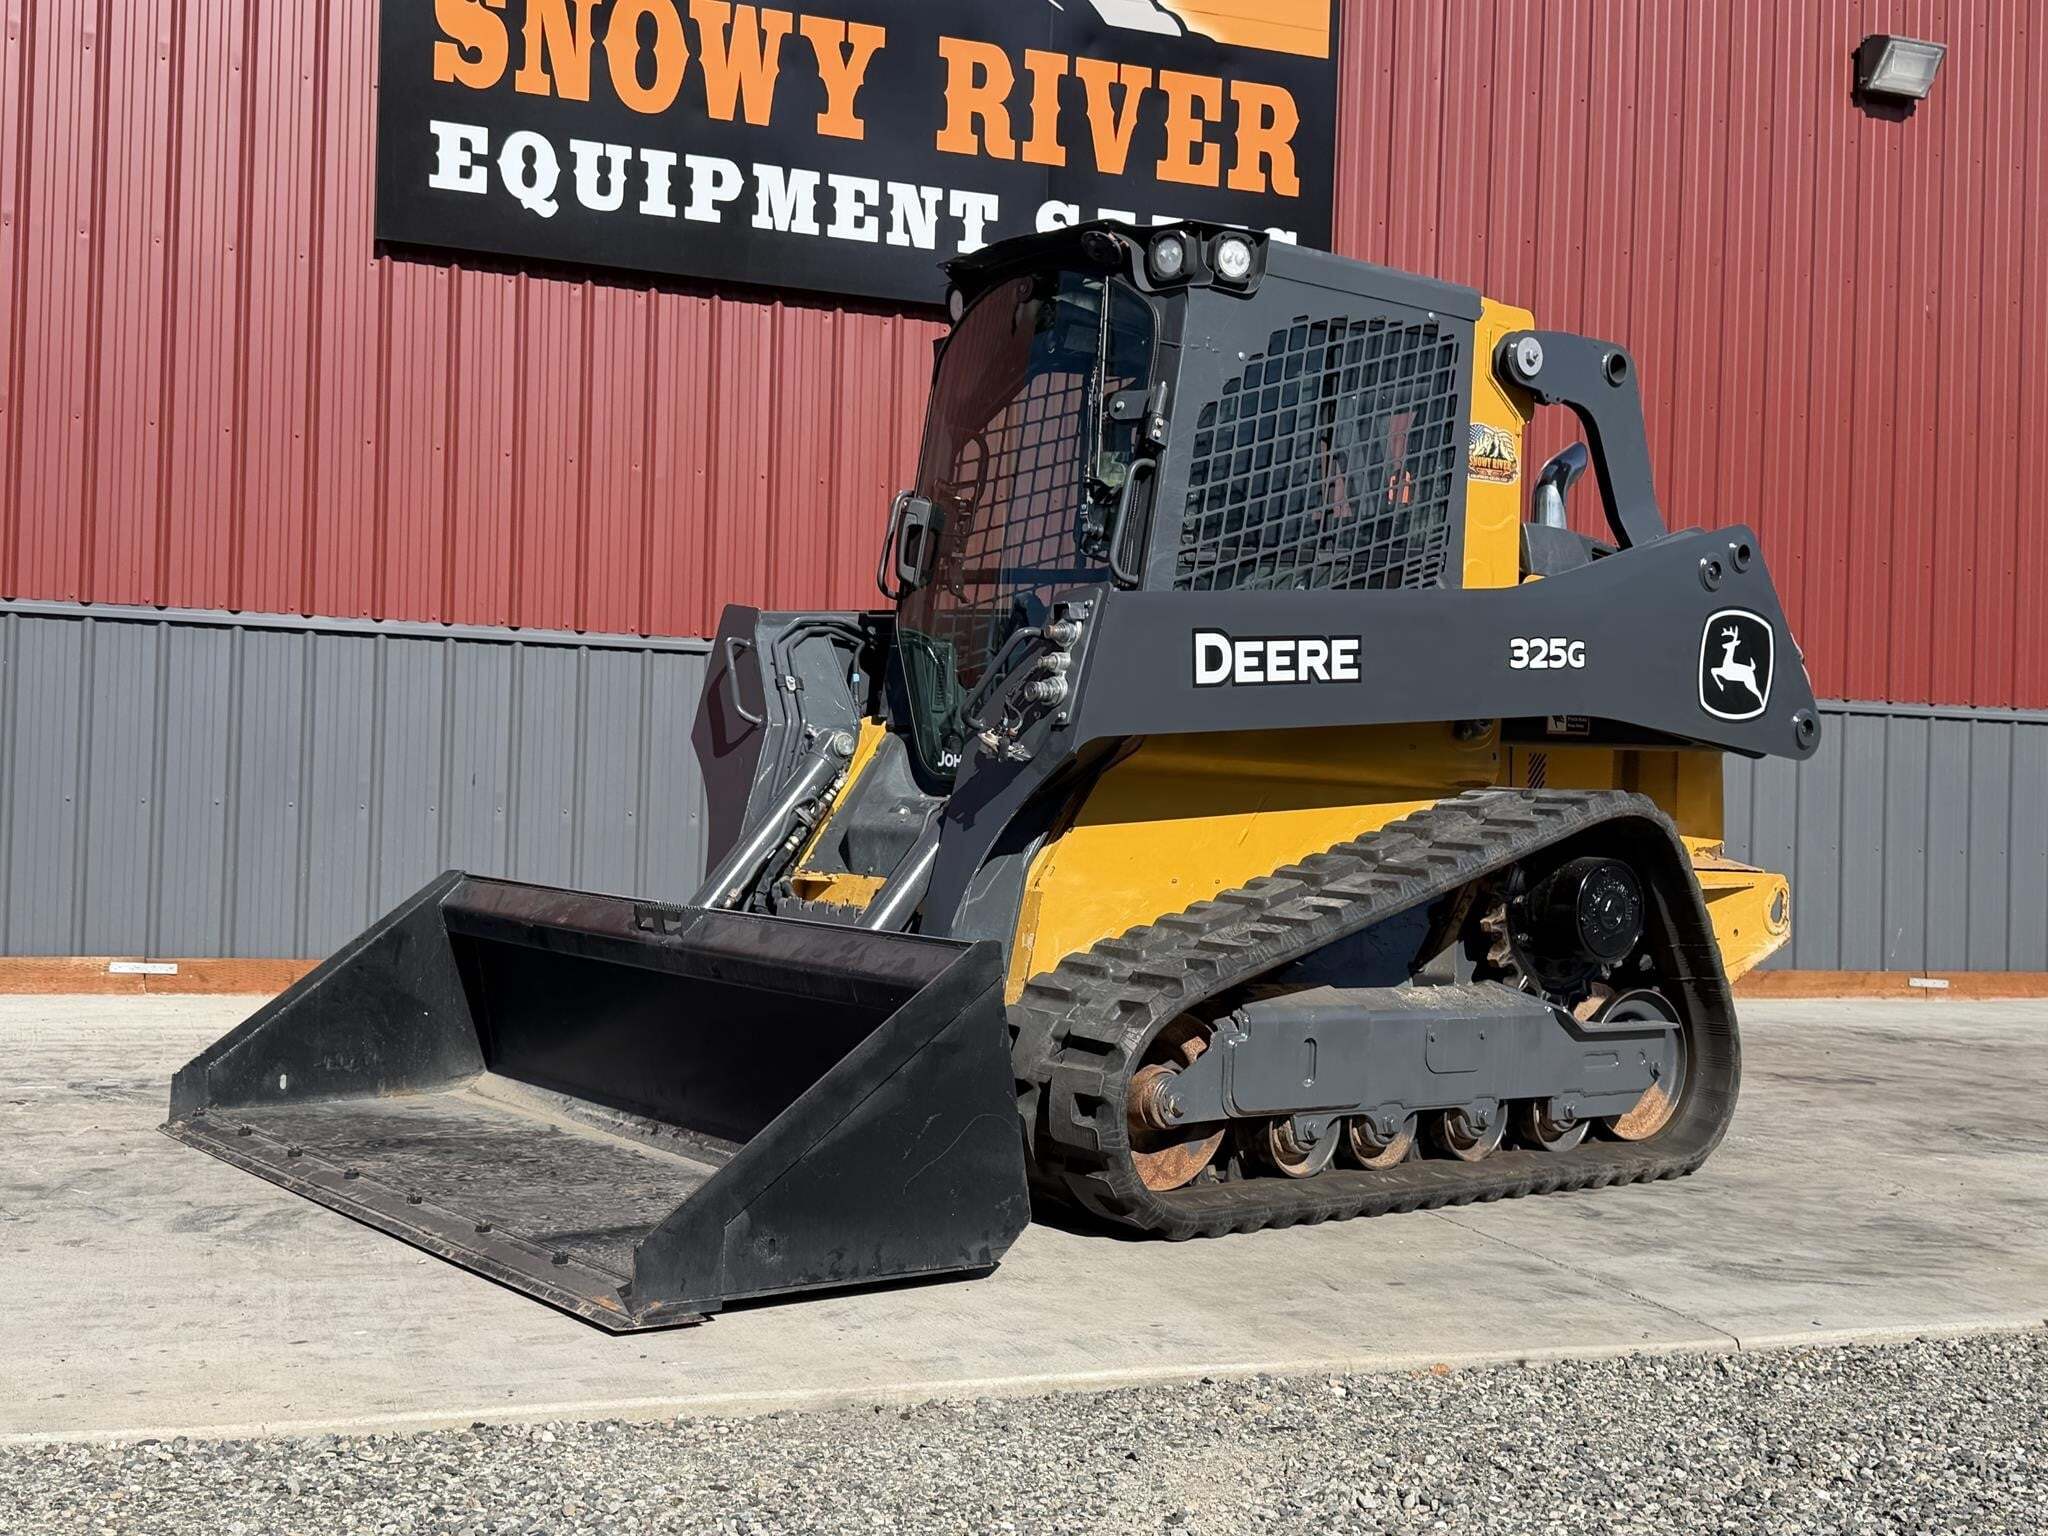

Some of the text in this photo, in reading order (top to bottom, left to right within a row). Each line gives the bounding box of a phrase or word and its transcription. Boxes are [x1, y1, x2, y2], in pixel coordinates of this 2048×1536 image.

[434, 0, 1299, 196] SNOWY RIVER
[429, 120, 998, 255] EQUIPMENT
[1196, 633, 1358, 683] DEERE
[1510, 638, 1585, 668] 325G
[937, 750, 962, 767] JOH
